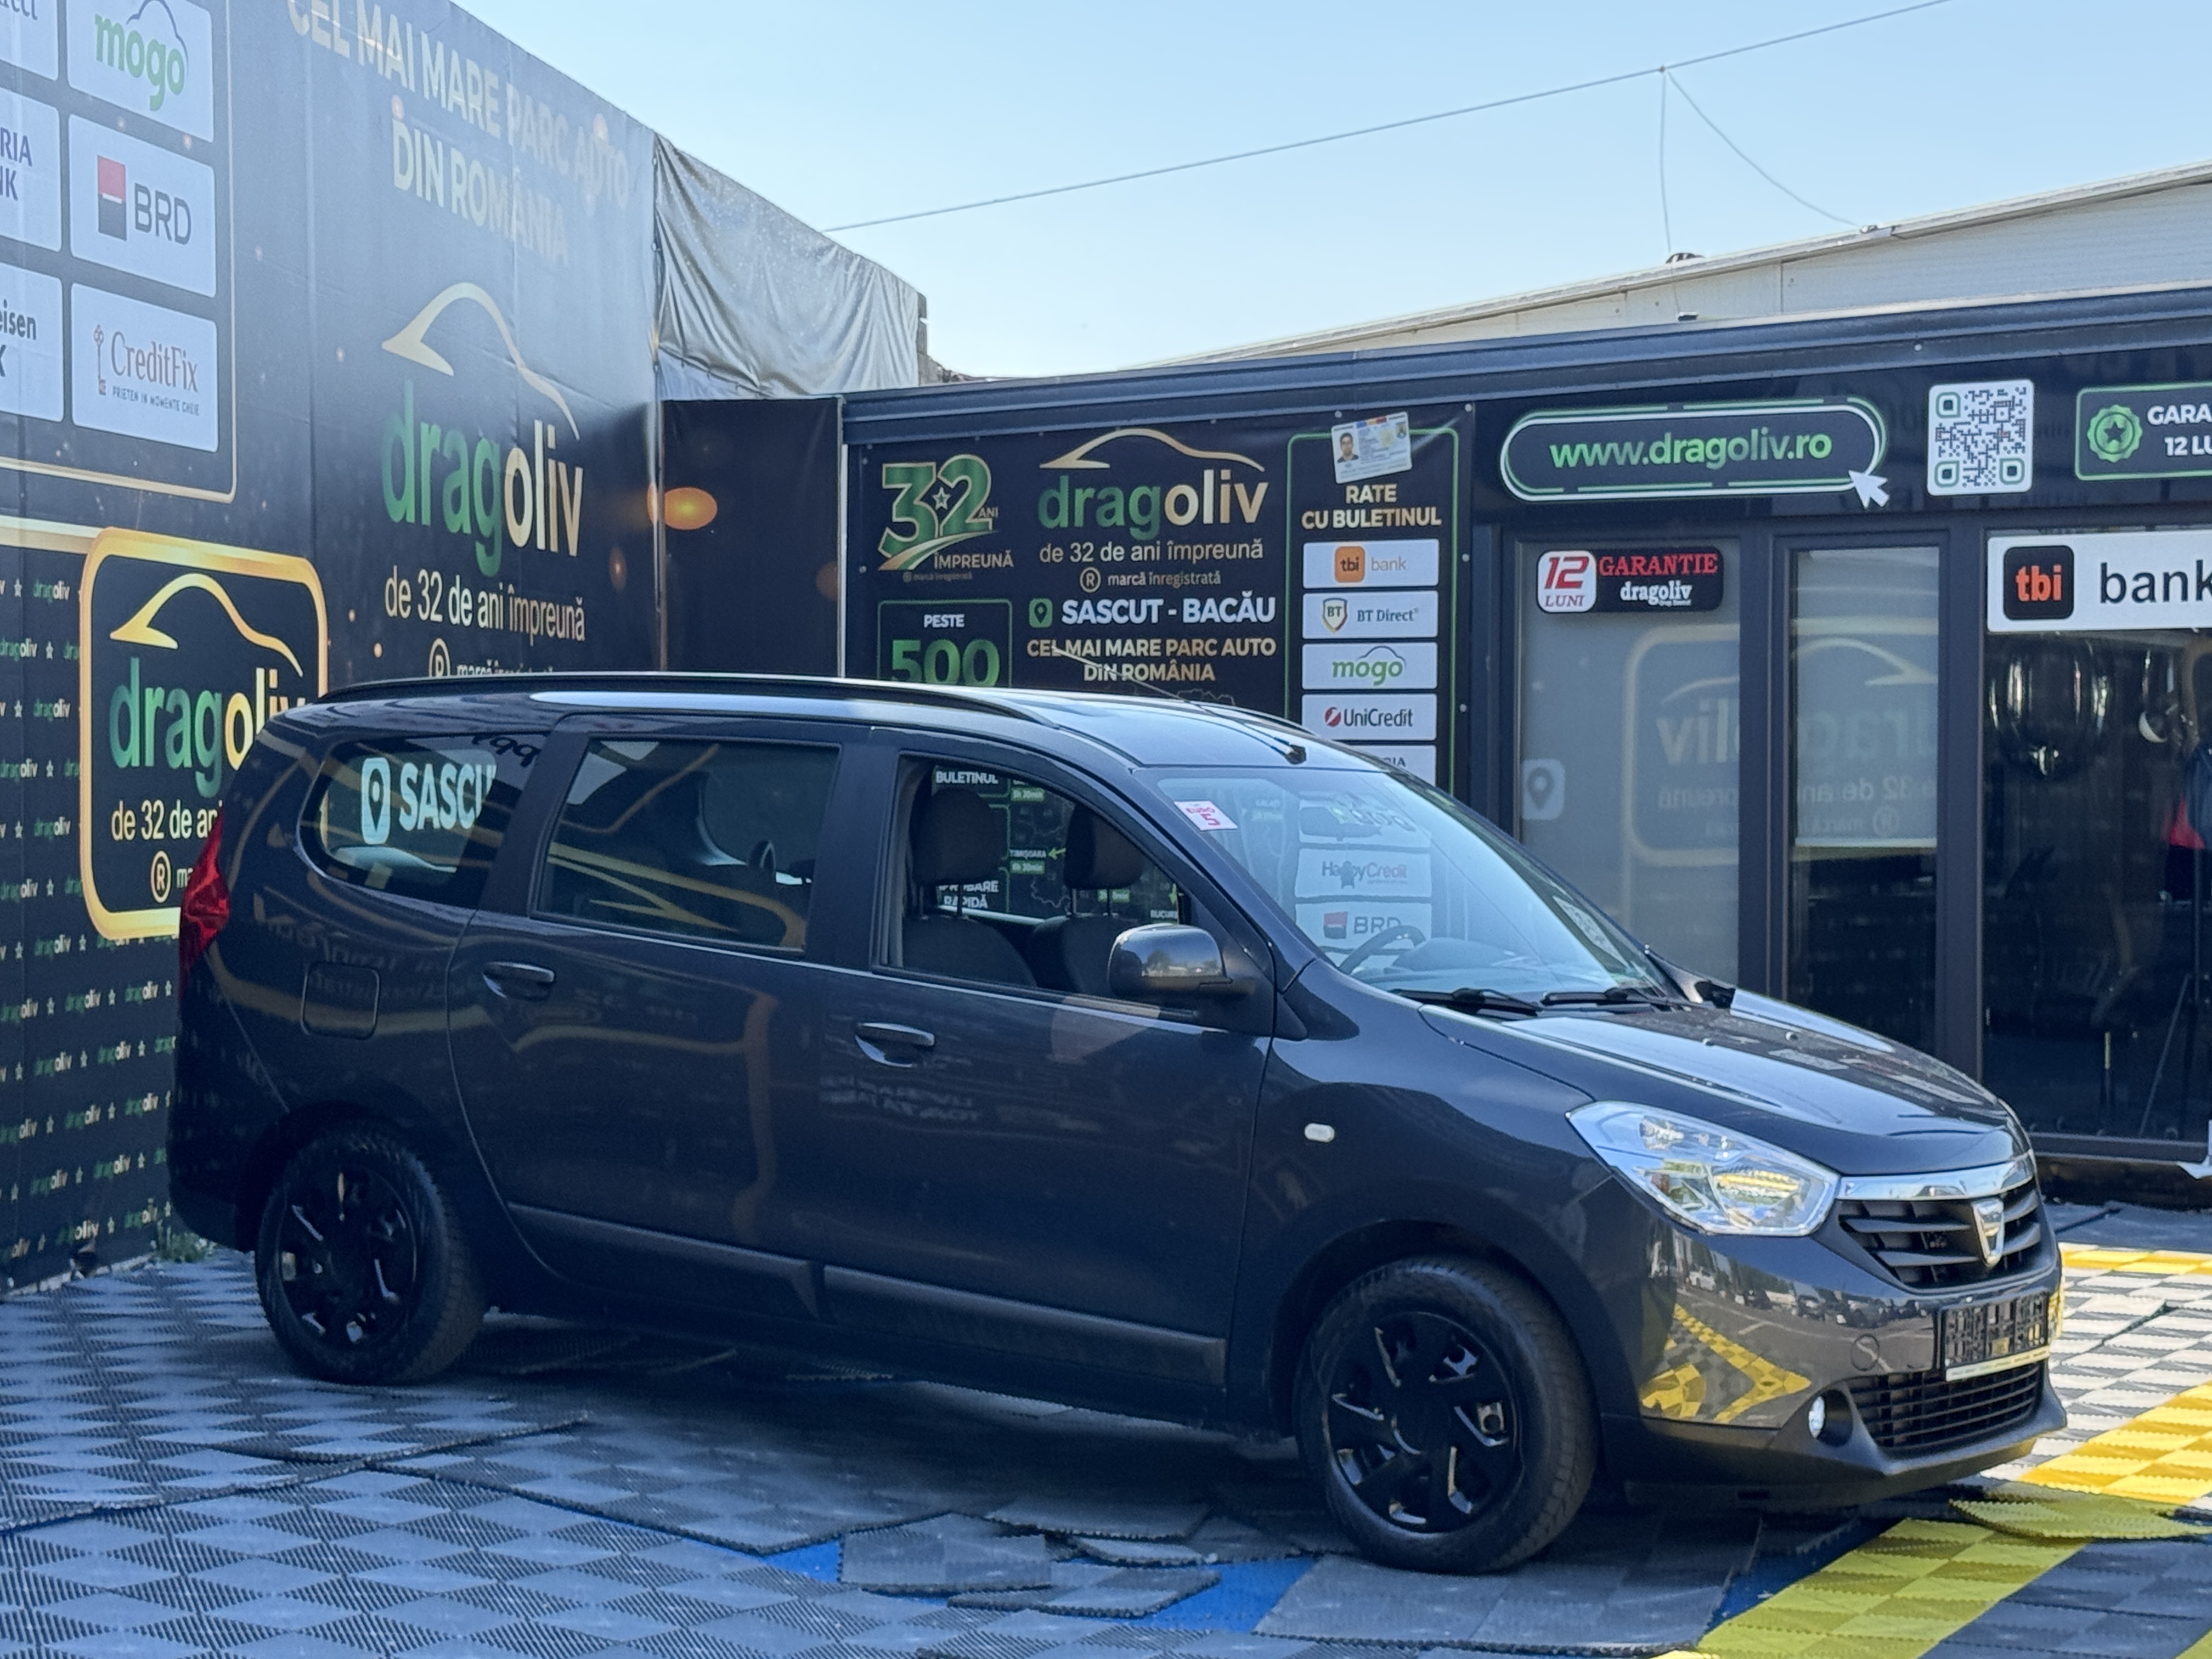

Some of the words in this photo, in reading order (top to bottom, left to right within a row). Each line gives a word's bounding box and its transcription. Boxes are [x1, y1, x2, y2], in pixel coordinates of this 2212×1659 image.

[95, 14, 185, 111] mogo
[357, 0, 415, 92] MAI
[421, 31, 501, 139] MARE
[392, 119, 444, 208] DIN
[134, 183, 191, 245] BRD
[111, 331, 198, 393] CreditFix
[1549, 427, 1832, 470] www.dragoliv.ro
[2164, 437, 2188, 456] 12
[382, 377, 584, 578] dragoliv
[878, 454, 992, 558] 32
[1039, 469, 1269, 540] dragoliv
[1346, 483, 1397, 504] RATE
[978, 506, 998, 518] ANI
[1301, 510, 1329, 529] CU
[1333, 506, 1442, 528] BULETINUL
[933, 550, 1014, 569] ÎMPREUNĂ
[1040, 544, 1064, 563] de
[1070, 542, 1094, 562] 32
[1101, 541, 1125, 562] de
[1131, 541, 1161, 561] ani
[1167, 538, 1263, 565] împreună
[1340, 556, 1359, 572] tbi
[1371, 556, 1407, 572] bank
[1598, 553, 1719, 577] GARANTIE
[1108, 572, 1146, 586] marcă
[1149, 570, 1221, 589] înregistrată
[1544, 556, 1590, 590] 12
[2016, 563, 2062, 602] tbi
[2100, 558, 2212, 604] bank
[385, 566, 411, 619] de
[417, 568, 443, 622] 32
[449, 575, 472, 627] de
[478, 582, 504, 630] ani
[509, 584, 585, 647] împreună
[1544, 595, 1585, 607] LUNI
[1620, 580, 1692, 606] dragoliv
[924, 614, 965, 628] PESTE
[1062, 598, 1164, 624] SASCUT
[1183, 591, 1276, 623] BACĂU
[1327, 606, 1342, 617] BT
[1357, 610, 1374, 622] BT
[1027, 639, 1063, 657] CEL
[1065, 639, 1102, 657] MAI
[1105, 639, 1161, 657] MARE
[1166, 639, 1218, 657] PARC
[1222, 638, 1276, 656] AUTO
[892, 639, 1000, 687] 500
[1084, 664, 1117, 681] DIN
[1122, 660, 1216, 681] ROMÂNIA
[1331, 661, 1403, 686] mogo
[110, 657, 306, 798] dragoli
[1344, 708, 1414, 727] UniCredit
[935, 771, 999, 785] BULETINUL
[399, 762, 497, 832] SASCU
[111, 800, 136, 841] de
[141, 799, 165, 840] 32
[169, 799, 193, 839] de
[1200, 814, 1221, 826] 5
[1353, 916, 1402, 934] BRD
[34, 934, 71, 957] oliv
[0, 998, 39, 1025] oliv
[65, 989, 101, 1013] oliv
[125, 981, 159, 1005] oliv
[34, 1051, 72, 1077] oliv
[97, 1041, 132, 1065] oliv
[0, 1118, 38, 1144] oliv
[64, 1104, 101, 1131] oliv
[125, 1092, 159, 1116] oliv
[30, 1169, 69, 1197] oliv
[92, 1154, 131, 1180] oliv
